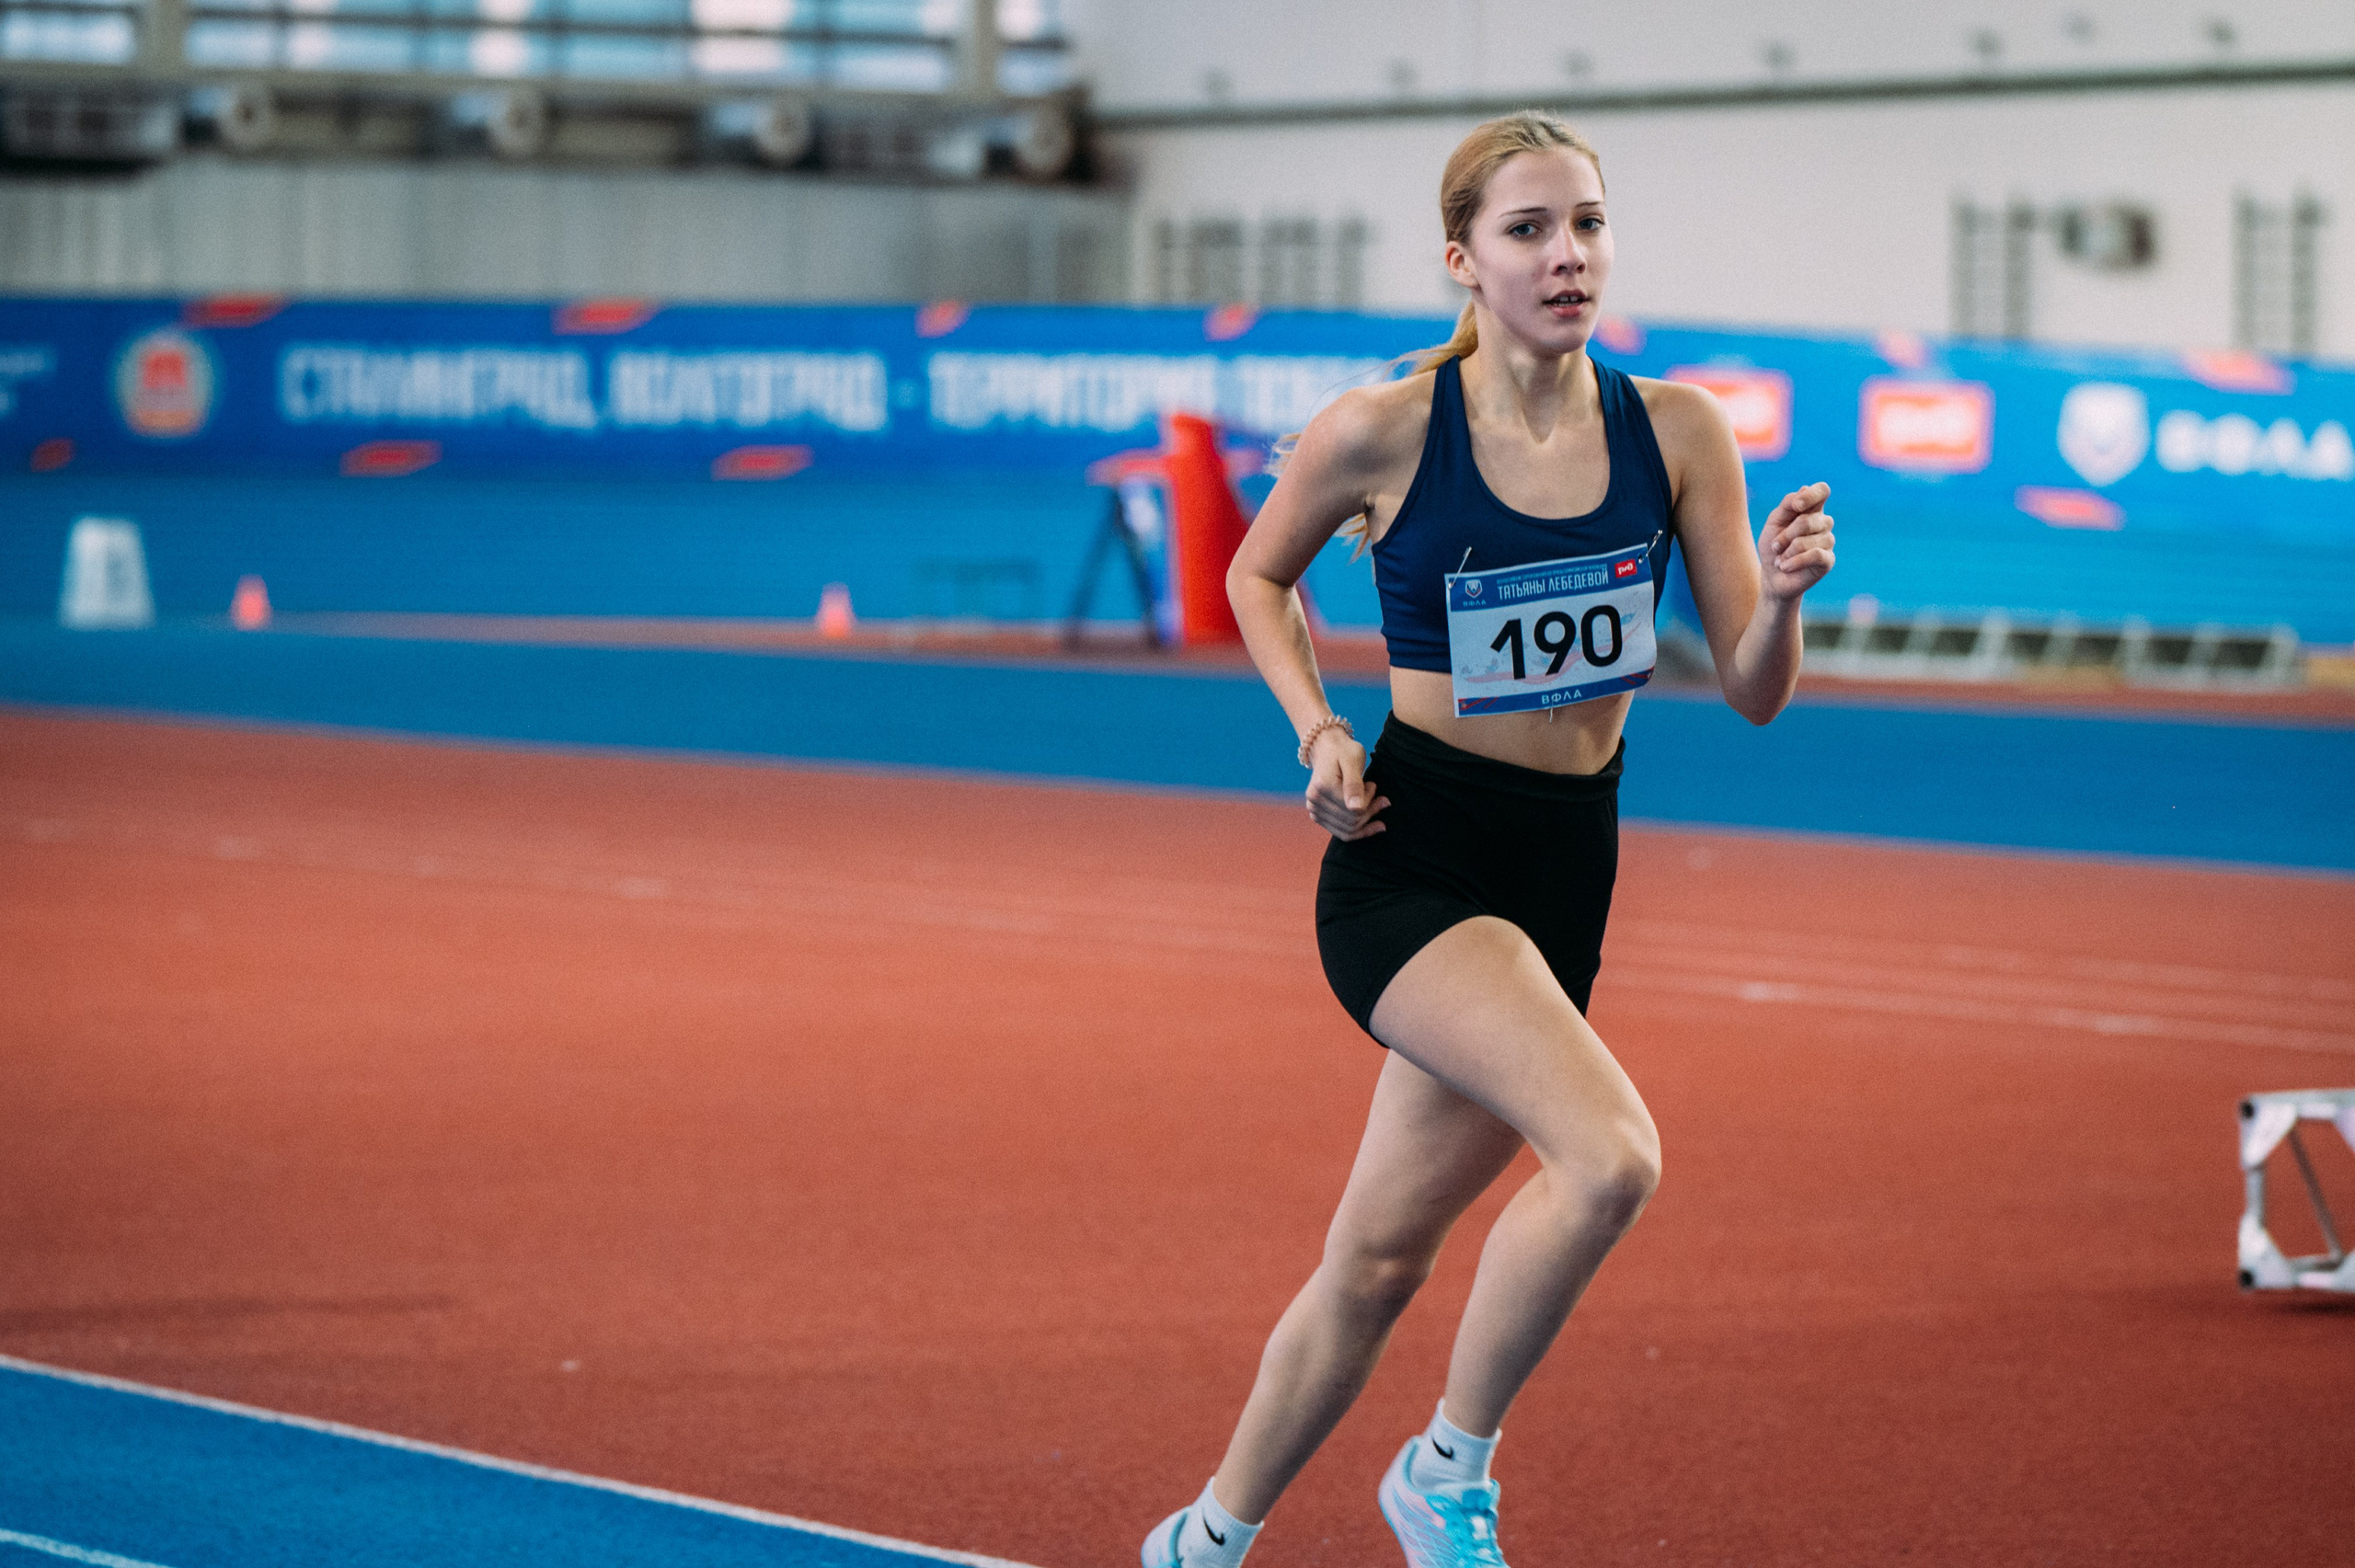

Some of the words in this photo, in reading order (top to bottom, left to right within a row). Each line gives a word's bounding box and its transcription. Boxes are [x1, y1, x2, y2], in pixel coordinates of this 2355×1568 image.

[1498, 578, 1546, 601] ТАТЬЯНЫ
[1548, 567, 1609, 591] ЛЕБЕДЕВОЙ
[1491, 605, 1623, 680] 190
[1541, 689, 1582, 704] ВФЛА
